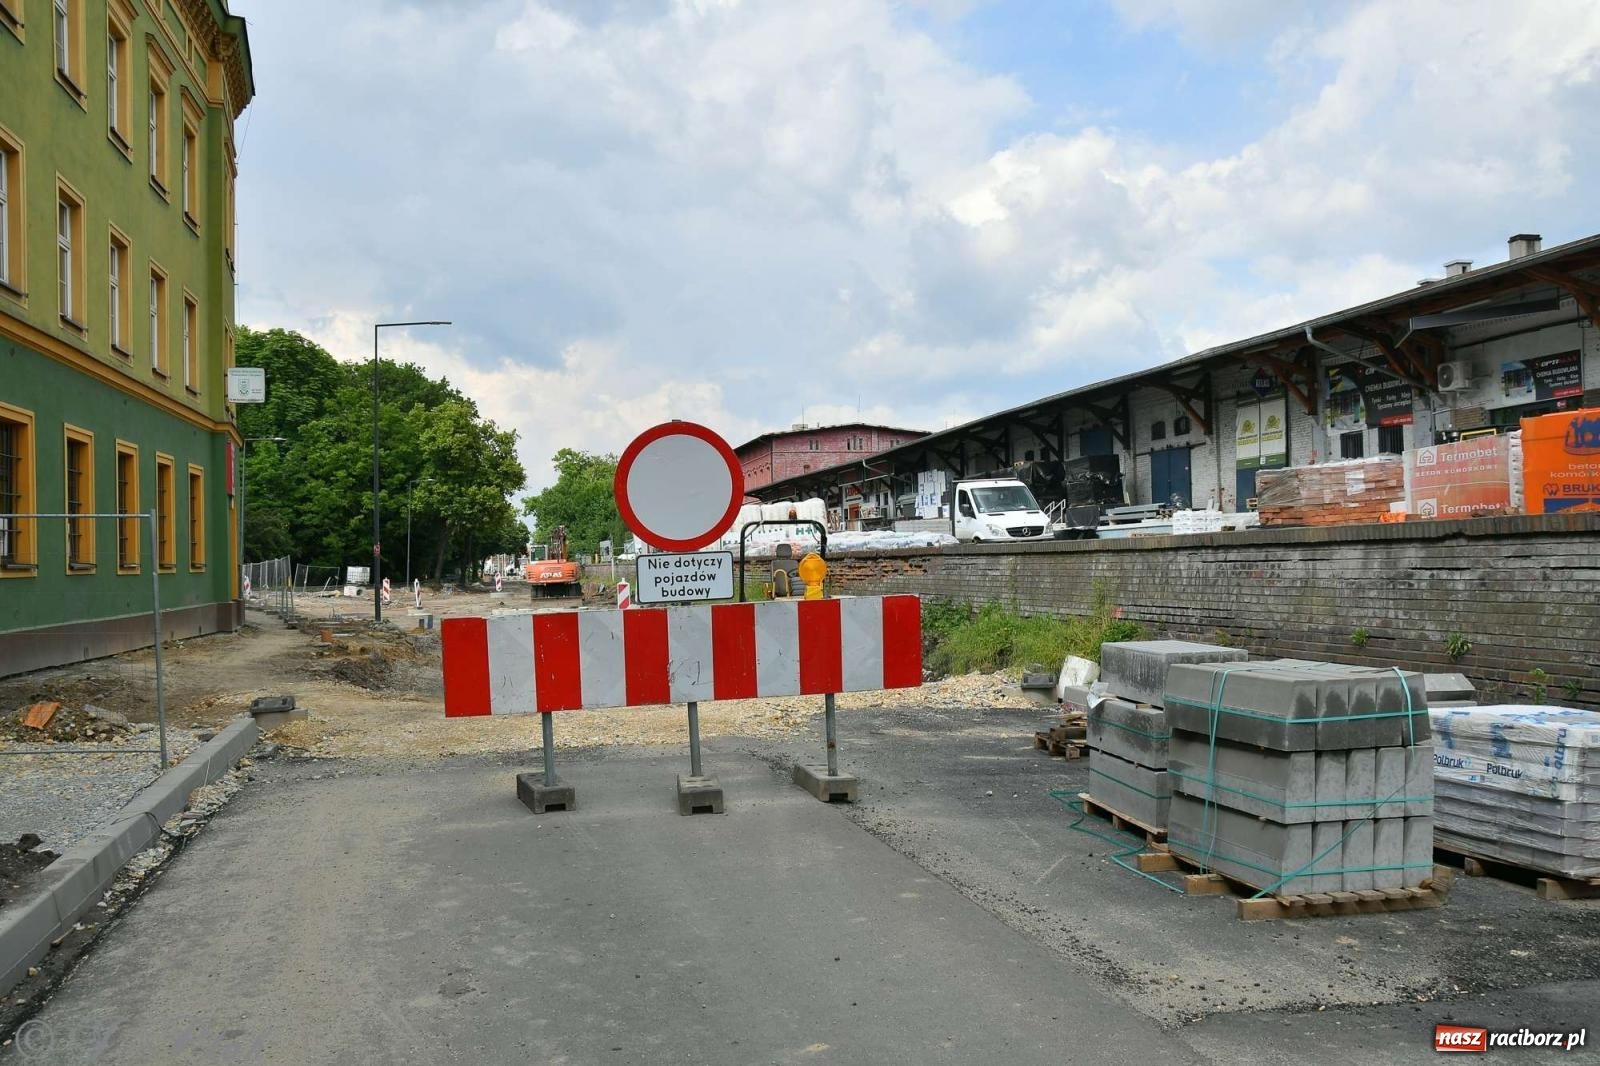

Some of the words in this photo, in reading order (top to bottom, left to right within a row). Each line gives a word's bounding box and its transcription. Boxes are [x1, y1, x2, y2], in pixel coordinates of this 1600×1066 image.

[1441, 448, 1497, 462] Termobet
[648, 558, 670, 570] Nie
[674, 556, 723, 570] dotyczy
[654, 571, 717, 587] pojazdów
[661, 585, 711, 598] budowy
[1486, 763, 1523, 779] Polbruk
